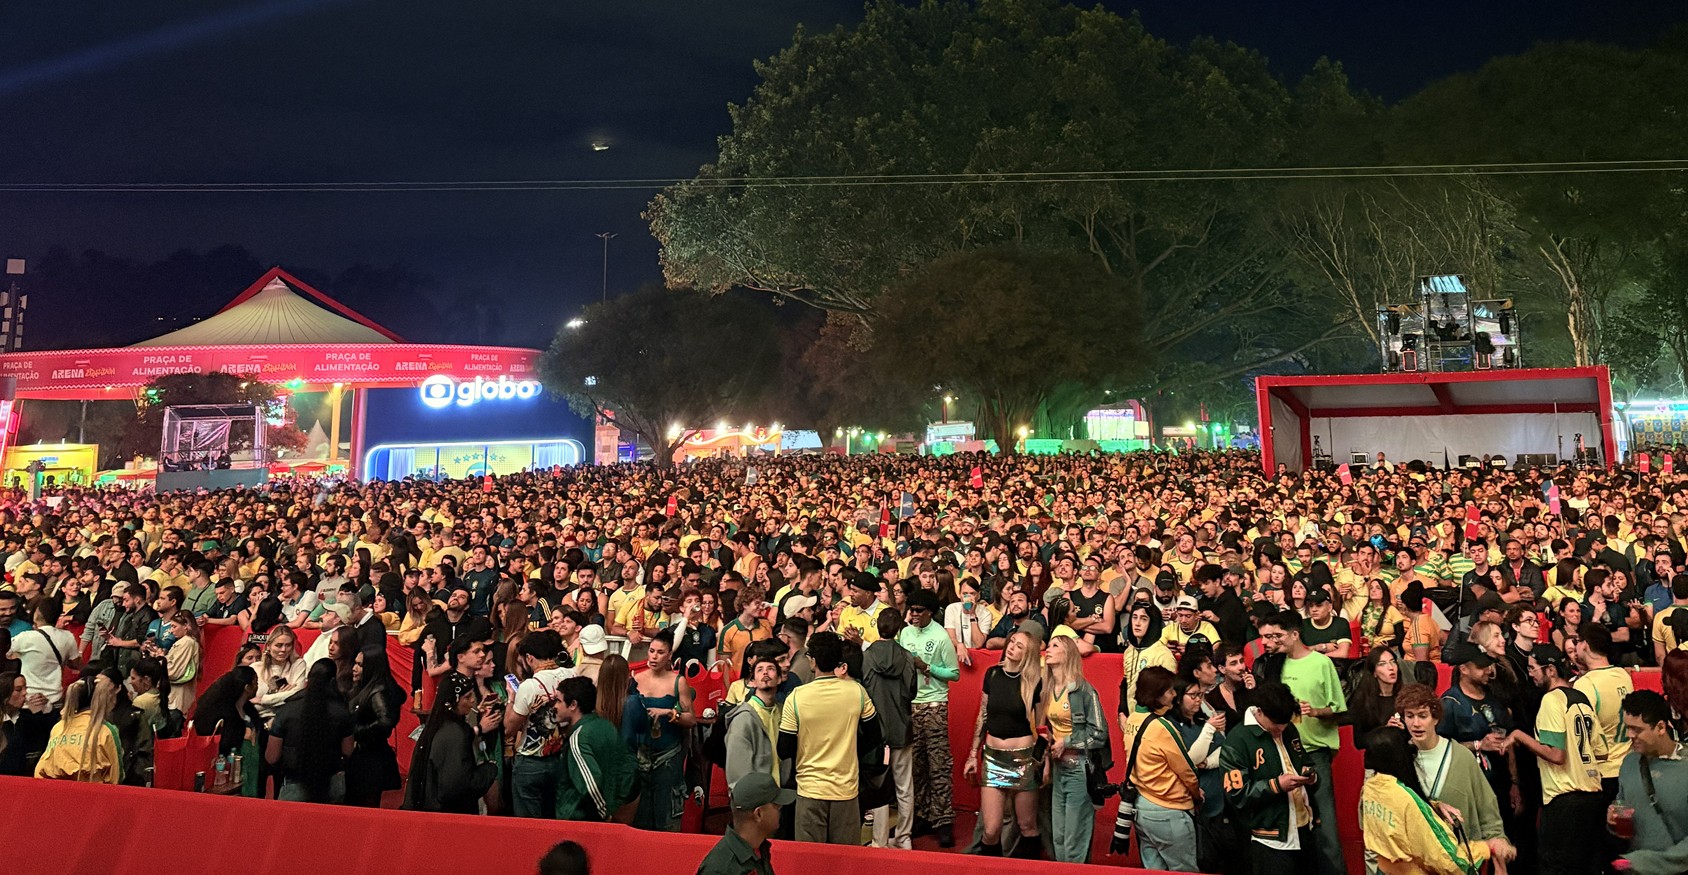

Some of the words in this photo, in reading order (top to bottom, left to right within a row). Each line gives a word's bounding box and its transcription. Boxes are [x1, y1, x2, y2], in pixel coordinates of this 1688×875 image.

[143, 356, 176, 365] PRAÇA
[178, 355, 192, 363] DE
[325, 353, 357, 362] PRAÇA
[471, 354, 490, 362] PRAÇA
[3, 362, 22, 370] PRAÇA
[23, 361, 33, 369] DE
[132, 365, 202, 375] ALIMENTAÇÃO
[220, 364, 261, 373] ARENA
[314, 362, 380, 373] ALIMENTAÇÃO
[395, 361, 428, 371] ARENA
[464, 363, 503, 372] ALIMENTAÇÃO
[52, 368, 84, 379] ARENA
[456, 375, 536, 407] globo
[1223, 769, 1244, 793] 49
[1364, 799, 1396, 829] RASIL
